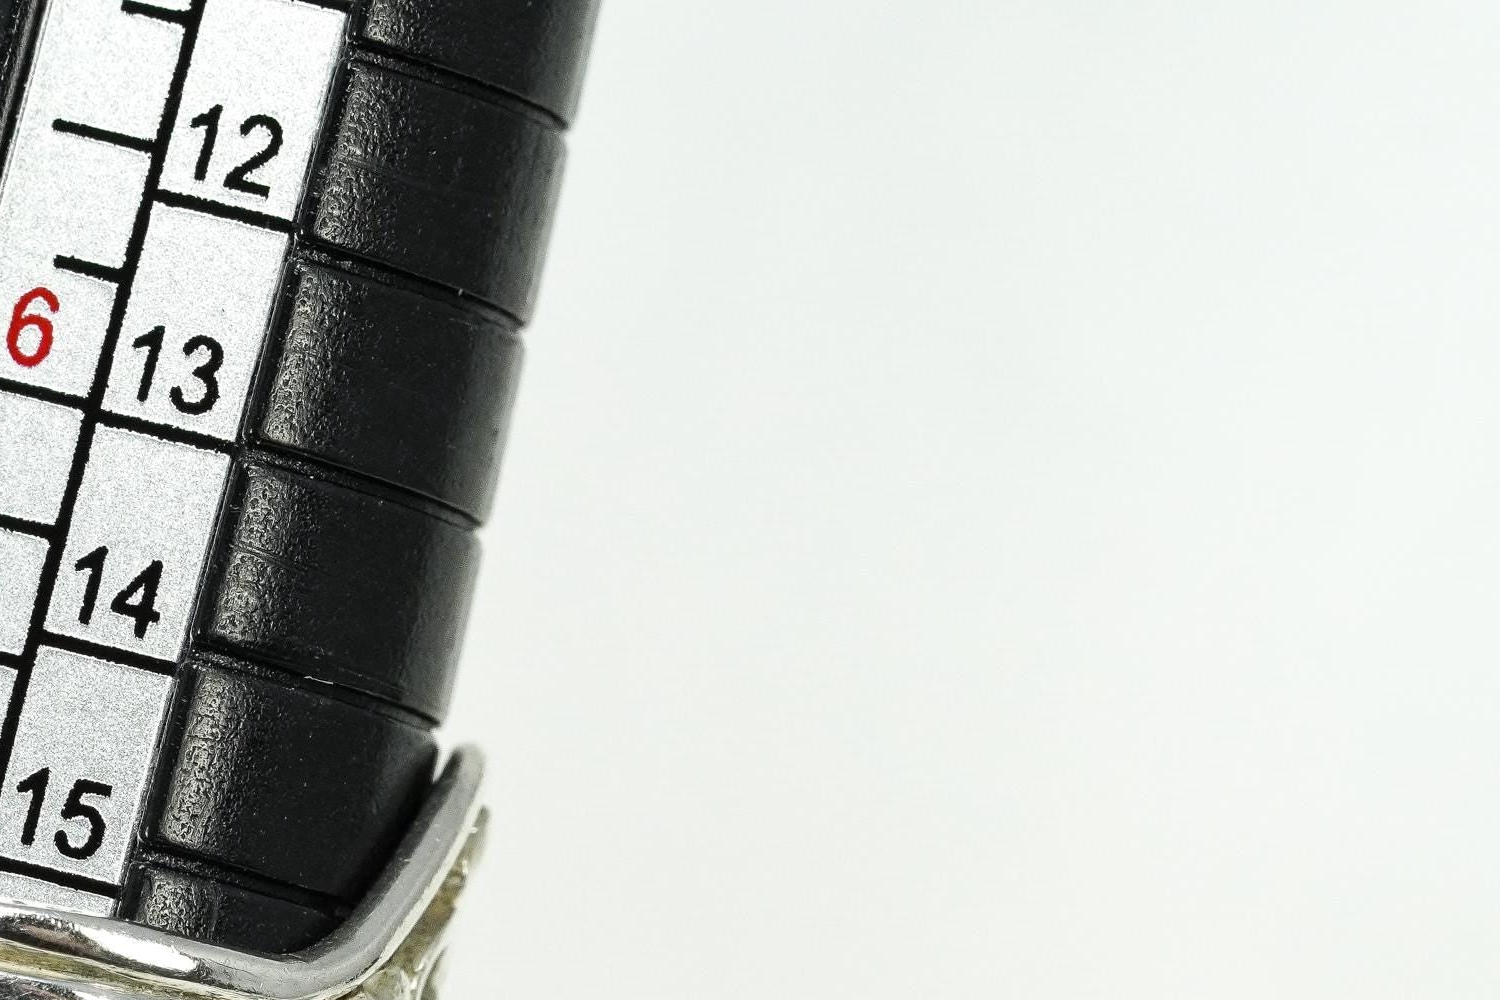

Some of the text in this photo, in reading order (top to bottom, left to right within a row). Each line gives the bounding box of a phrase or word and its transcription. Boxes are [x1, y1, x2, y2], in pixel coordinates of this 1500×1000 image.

[189, 103, 284, 200] 12
[6, 287, 60, 368] 6
[131, 325, 225, 416] 13
[74, 545, 164, 641] 14
[16, 766, 113, 861] 15
